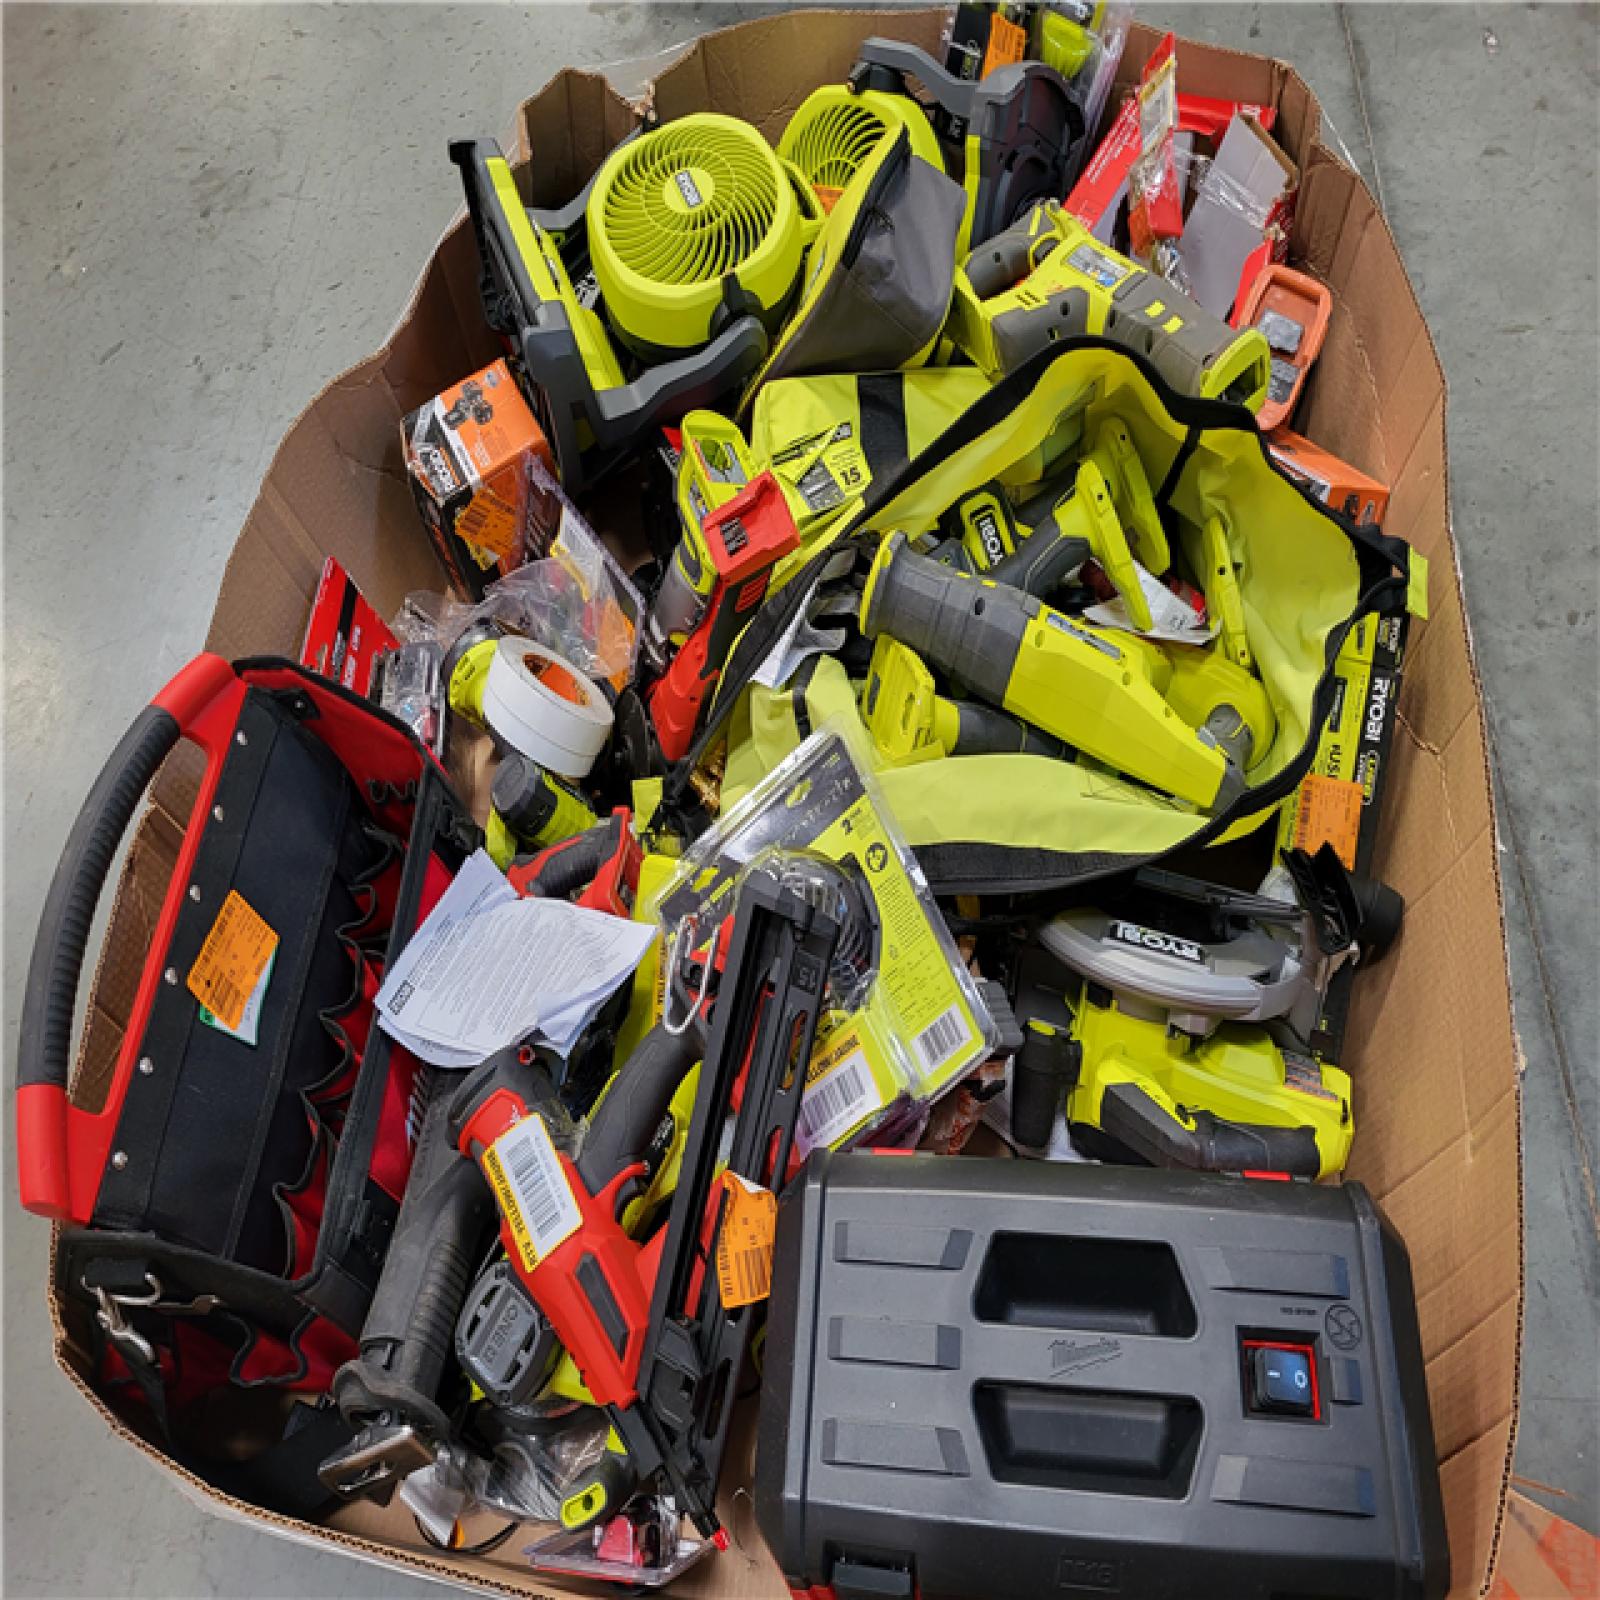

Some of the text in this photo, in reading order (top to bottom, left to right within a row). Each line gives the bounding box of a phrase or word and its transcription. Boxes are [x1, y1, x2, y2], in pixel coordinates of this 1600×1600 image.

[979, 517, 1004, 566] YOBI
[1364, 677, 1391, 743] RYOBI
[1117, 921, 1201, 961] RYOBI
